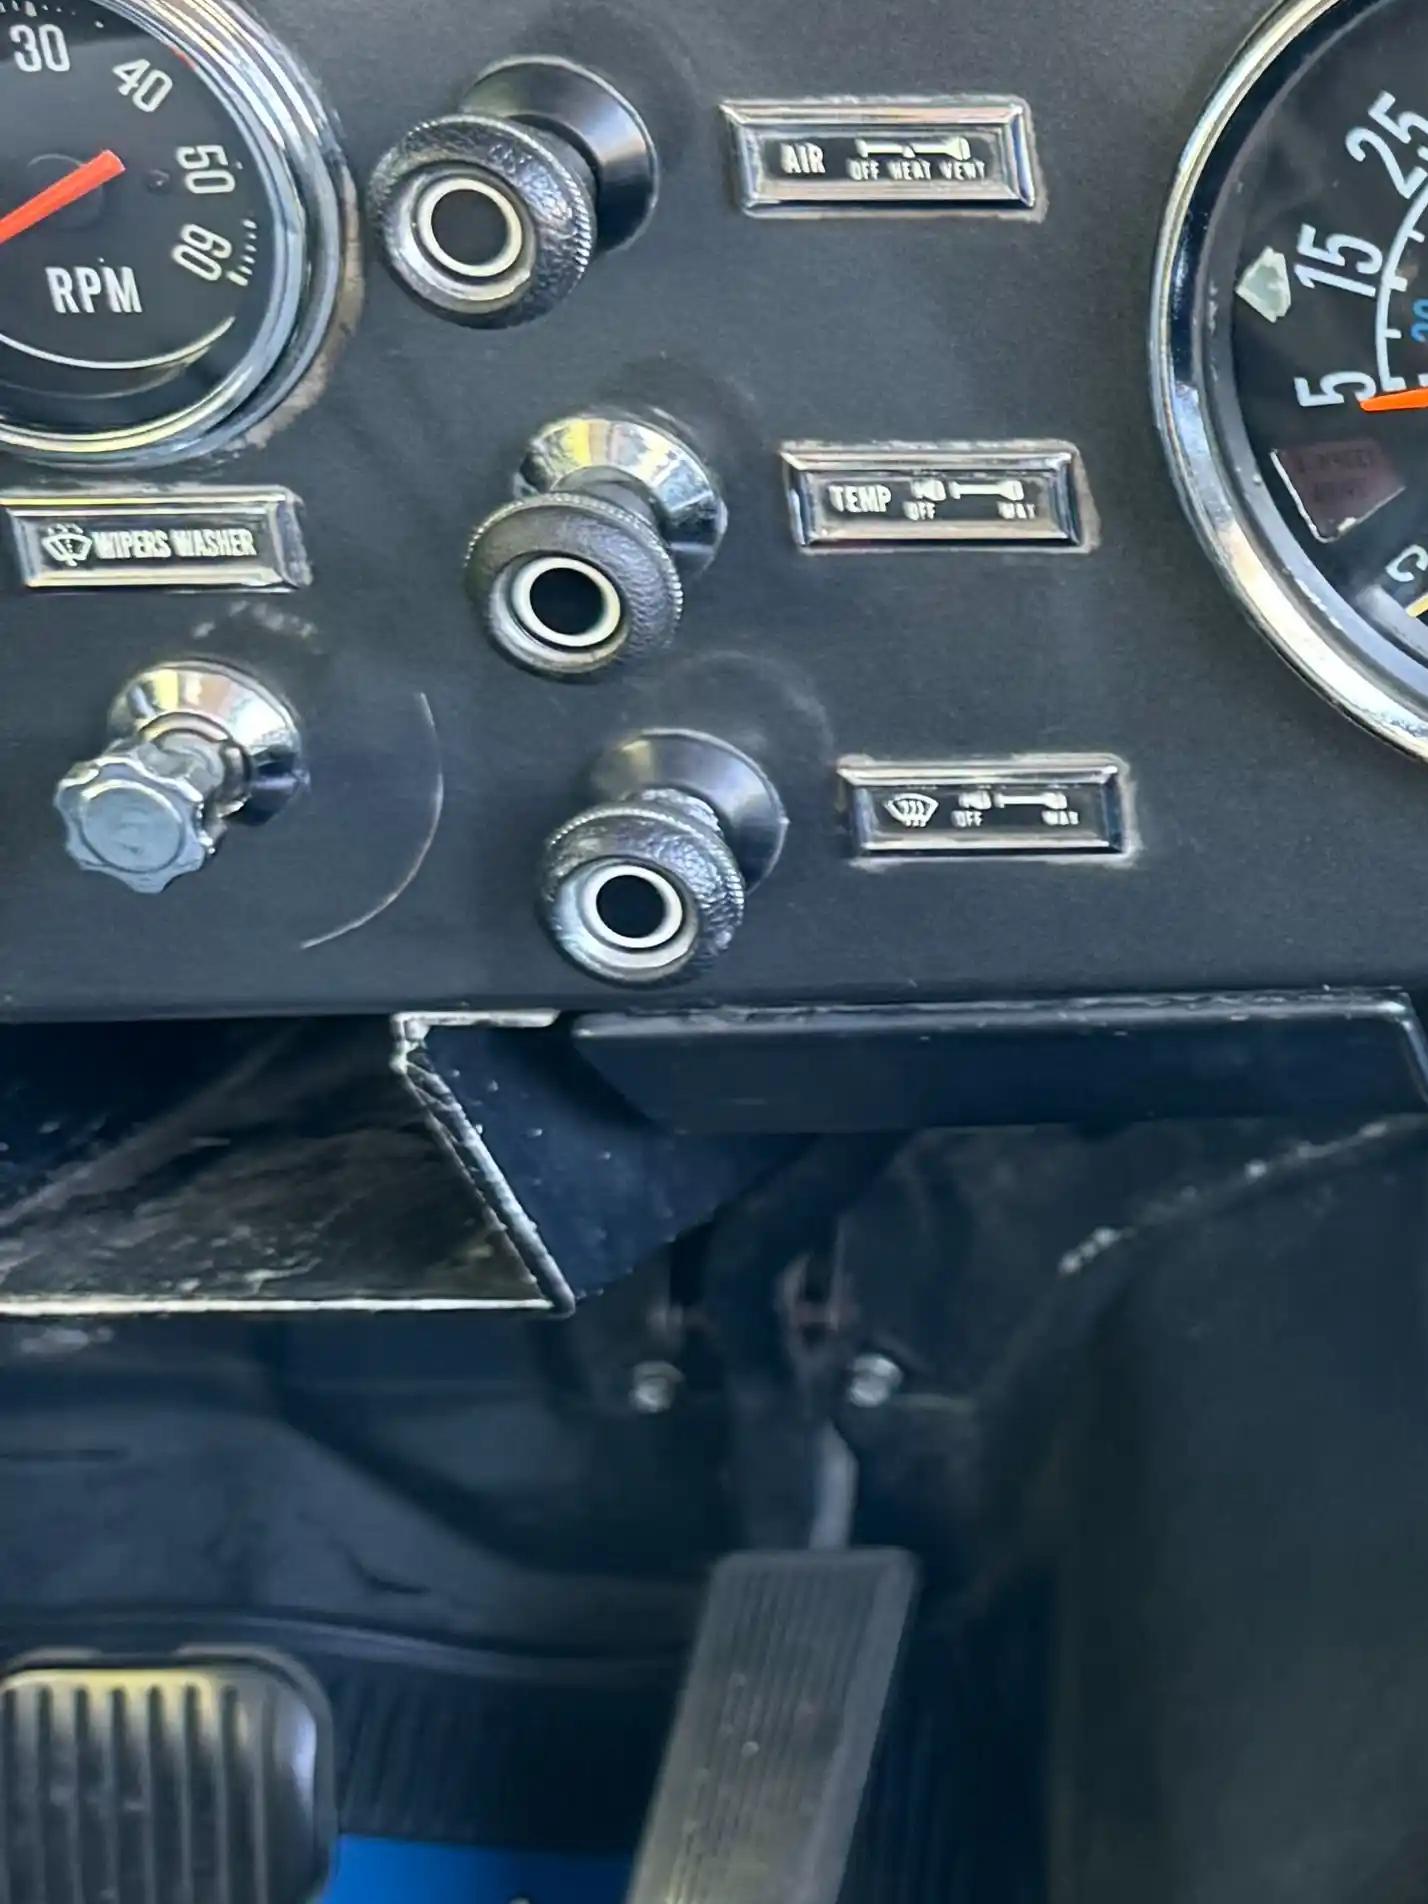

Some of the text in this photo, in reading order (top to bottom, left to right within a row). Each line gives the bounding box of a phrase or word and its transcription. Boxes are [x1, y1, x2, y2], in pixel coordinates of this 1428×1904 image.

[9, 24, 70, 73] 30
[112, 59, 173, 112] 40
[176, 145, 236, 194] 50
[780, 143, 826, 174] AIR
[846, 157, 985, 181] OFF HEAT VENT
[172, 224, 232, 281] 60
[1293, 224, 1384, 297] 15
[44, 266, 143, 313] RPM
[1294, 370, 1377, 408] 5
[828, 484, 892, 513] TEMP
[903, 501, 936, 521] OFF
[91, 529, 257, 559] WIPERS WASHER
[952, 810, 983, 827] OFF
